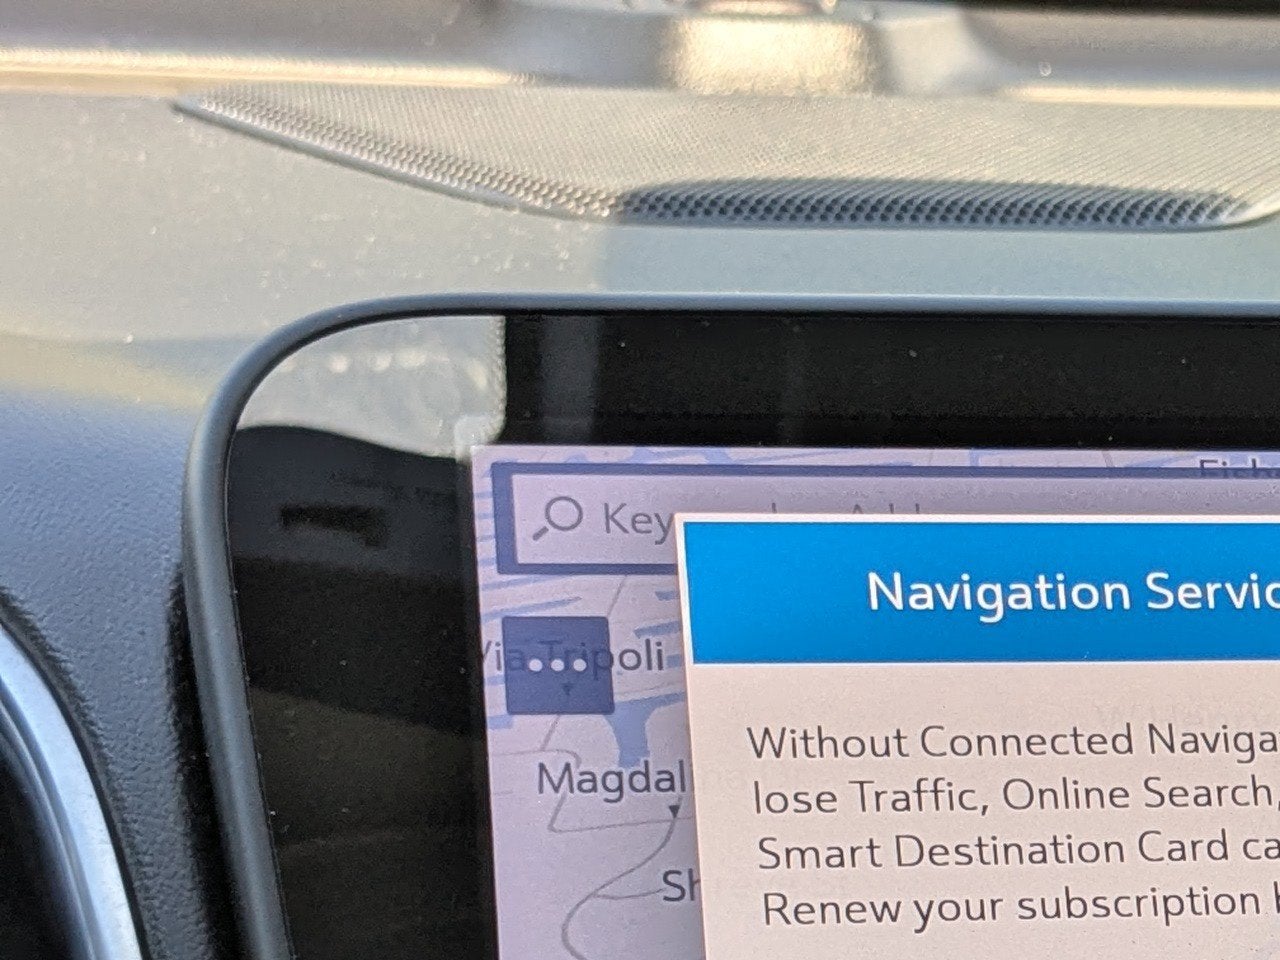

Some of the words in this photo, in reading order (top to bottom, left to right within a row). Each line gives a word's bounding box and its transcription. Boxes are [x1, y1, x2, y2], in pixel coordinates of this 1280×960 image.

[603, 502, 675, 545] Key
[868, 571, 1131, 623] Navigation
[746, 724, 910, 759] Without
[920, 722, 1134, 757] Connected
[537, 759, 687, 804] Magdal
[753, 780, 838, 814] lose
[848, 777, 989, 816] Traffic,
[1002, 776, 1130, 811] Online
[758, 836, 883, 870] Smart
[894, 833, 1125, 867] Destination
[1138, 827, 1229, 862] Card
[763, 892, 902, 926] Renew
[913, 898, 1004, 934] your
[1017, 885, 1261, 927] subscription
